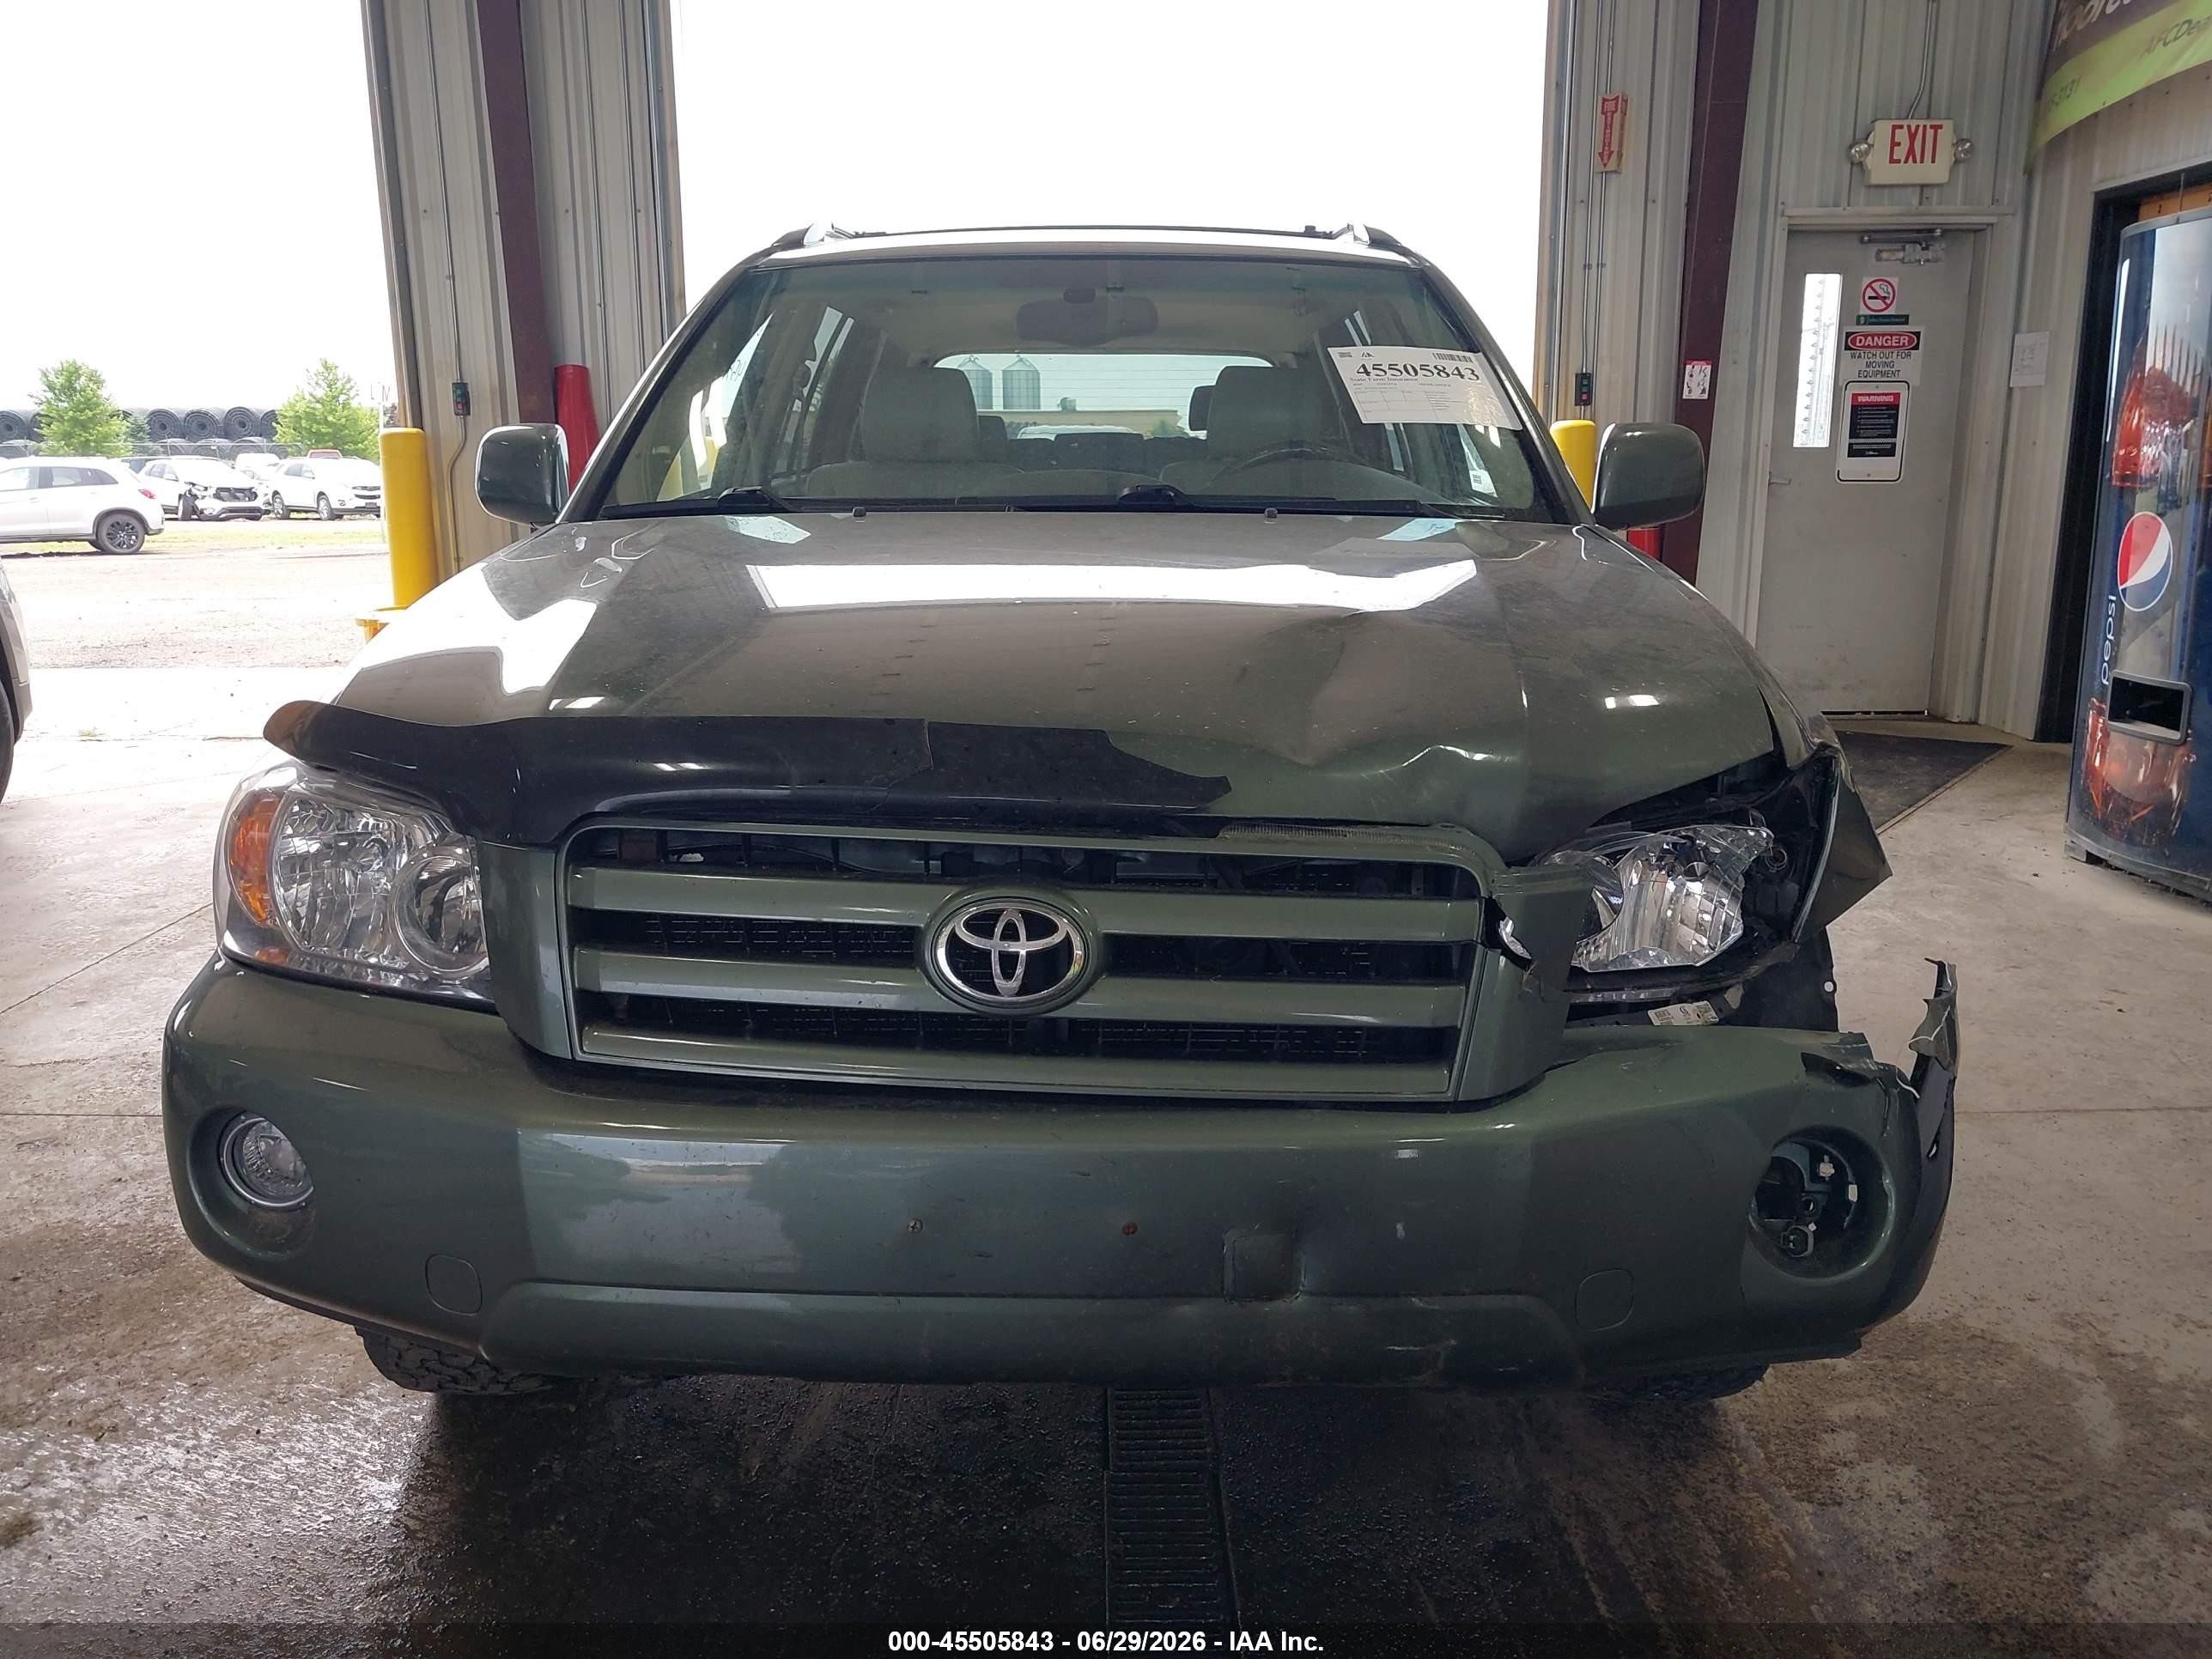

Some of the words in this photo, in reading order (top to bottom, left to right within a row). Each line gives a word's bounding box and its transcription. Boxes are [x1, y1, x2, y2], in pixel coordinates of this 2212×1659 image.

[1888, 124, 1943, 164] EXIT
[1856, 336, 1909, 347] DANGER
[1850, 351, 1877, 360] WATCH
[1356, 363, 1480, 381] 45505843
[1857, 369, 1901, 378] EQUIPMENT
[2101, 595, 2117, 685] pepsi
